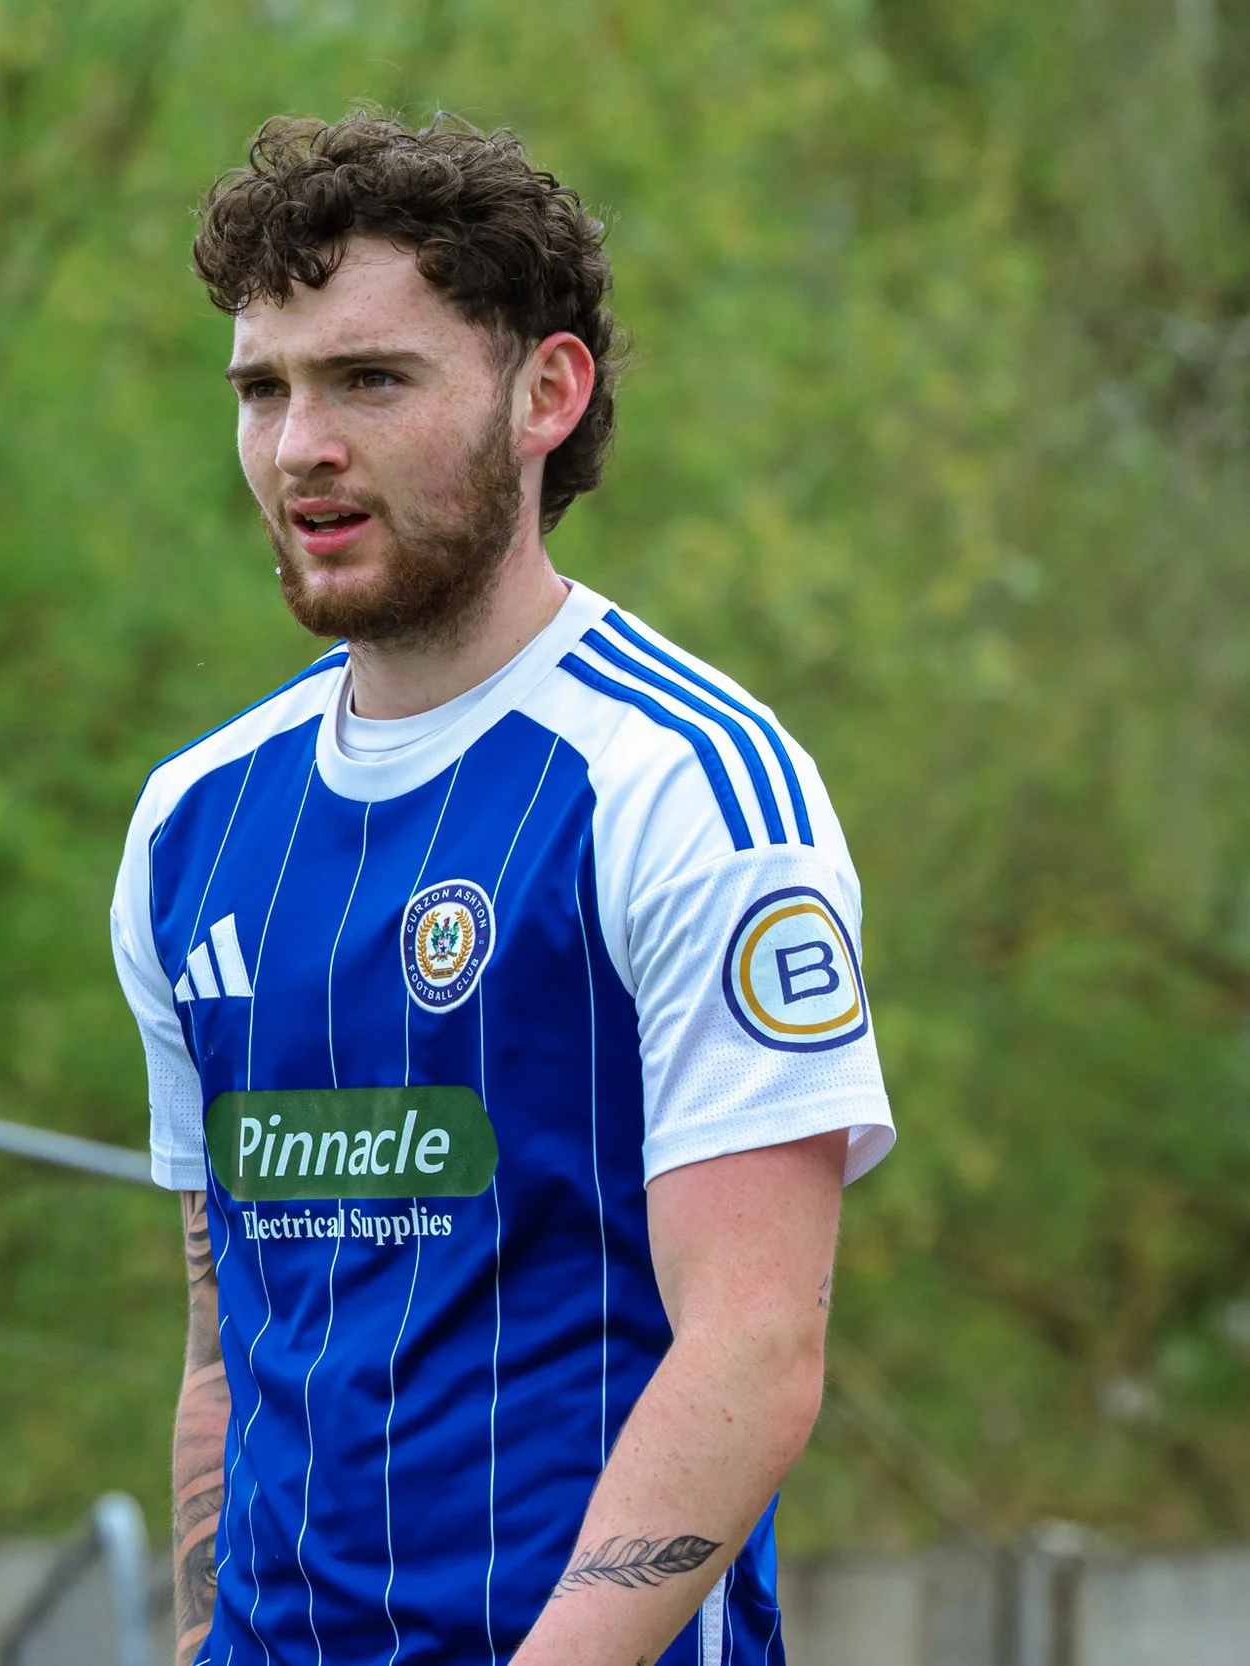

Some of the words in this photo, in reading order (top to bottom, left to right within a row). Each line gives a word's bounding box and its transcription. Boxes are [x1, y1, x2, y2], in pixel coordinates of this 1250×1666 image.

[406, 888, 450, 934] CURZON
[454, 888, 487, 929] ASHTON
[407, 964, 453, 1001] FOOTBALL
[455, 957, 479, 991] CLUB
[775, 940, 840, 1006] B
[238, 1109, 450, 1178] Pinnacle
[241, 1209, 346, 1240] Electrical
[350, 1206, 453, 1247] Supplies
